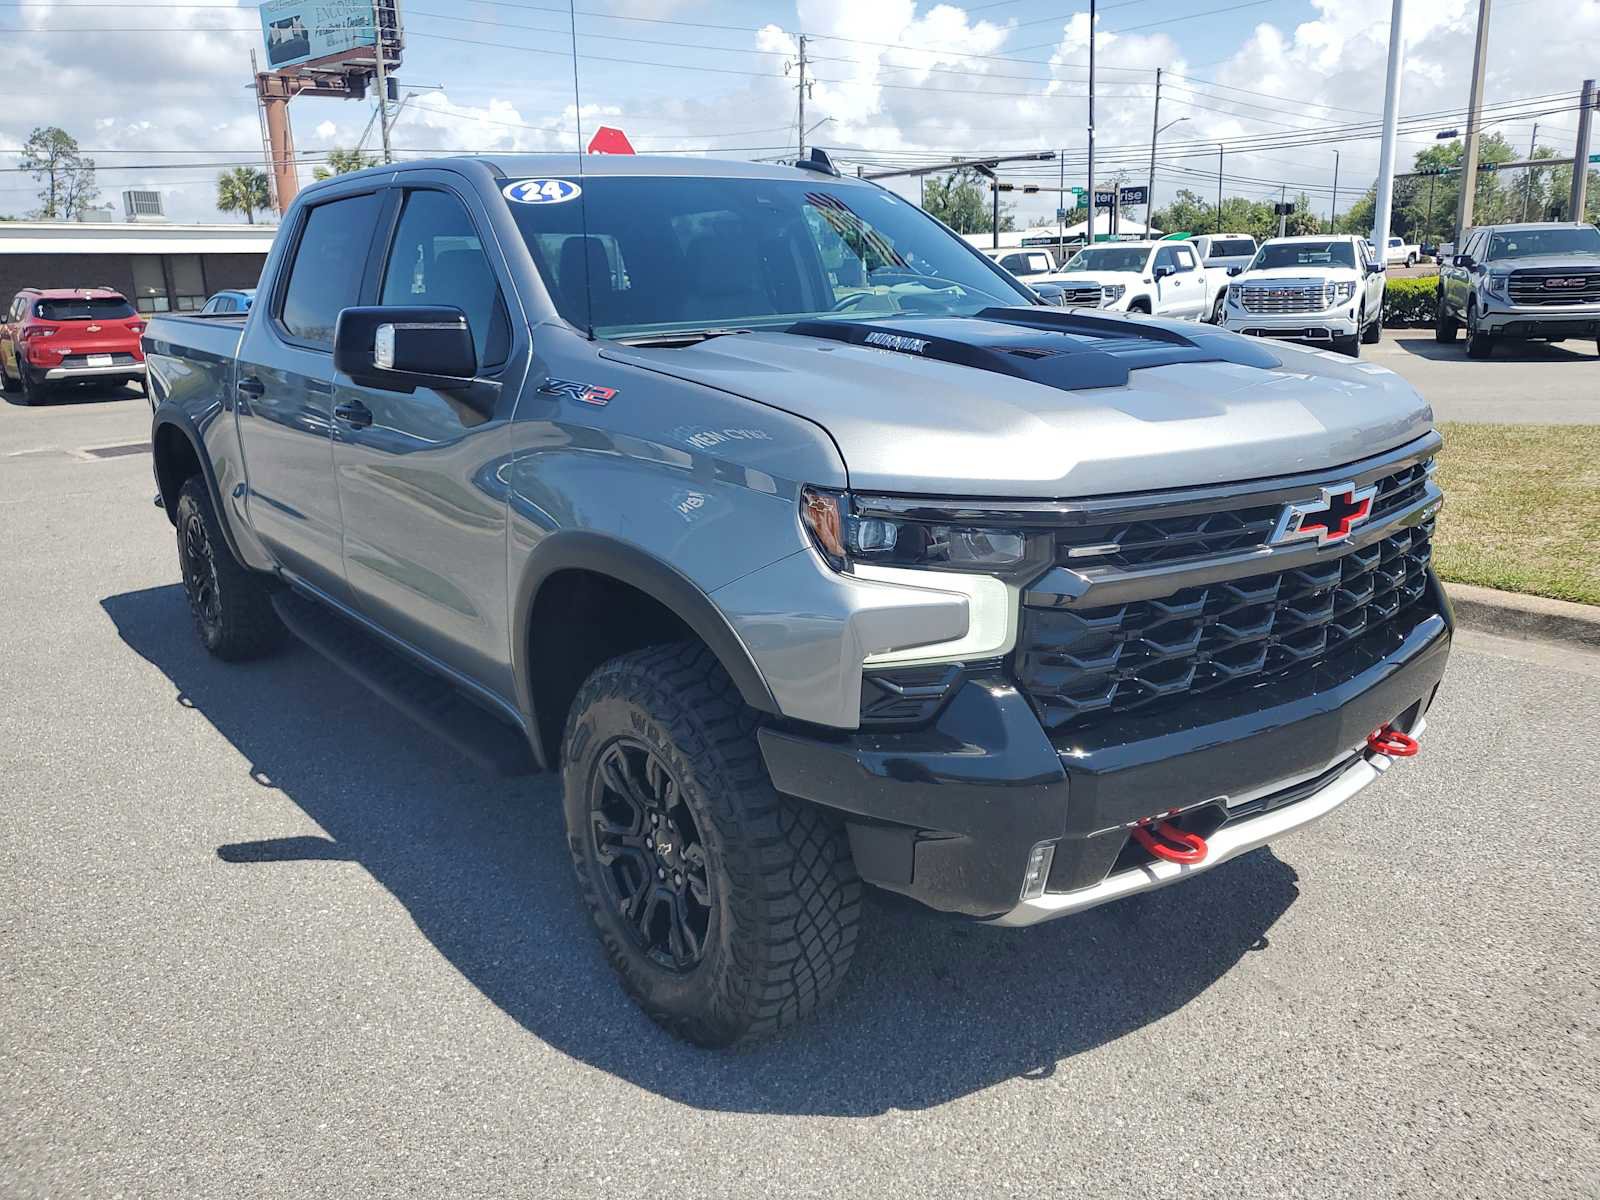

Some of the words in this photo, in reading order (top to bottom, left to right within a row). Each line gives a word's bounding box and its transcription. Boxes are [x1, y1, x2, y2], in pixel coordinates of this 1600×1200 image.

[520, 182, 564, 201] 24
[1080, 190, 1143, 204] eterrise
[536, 377, 620, 406] ZR2
